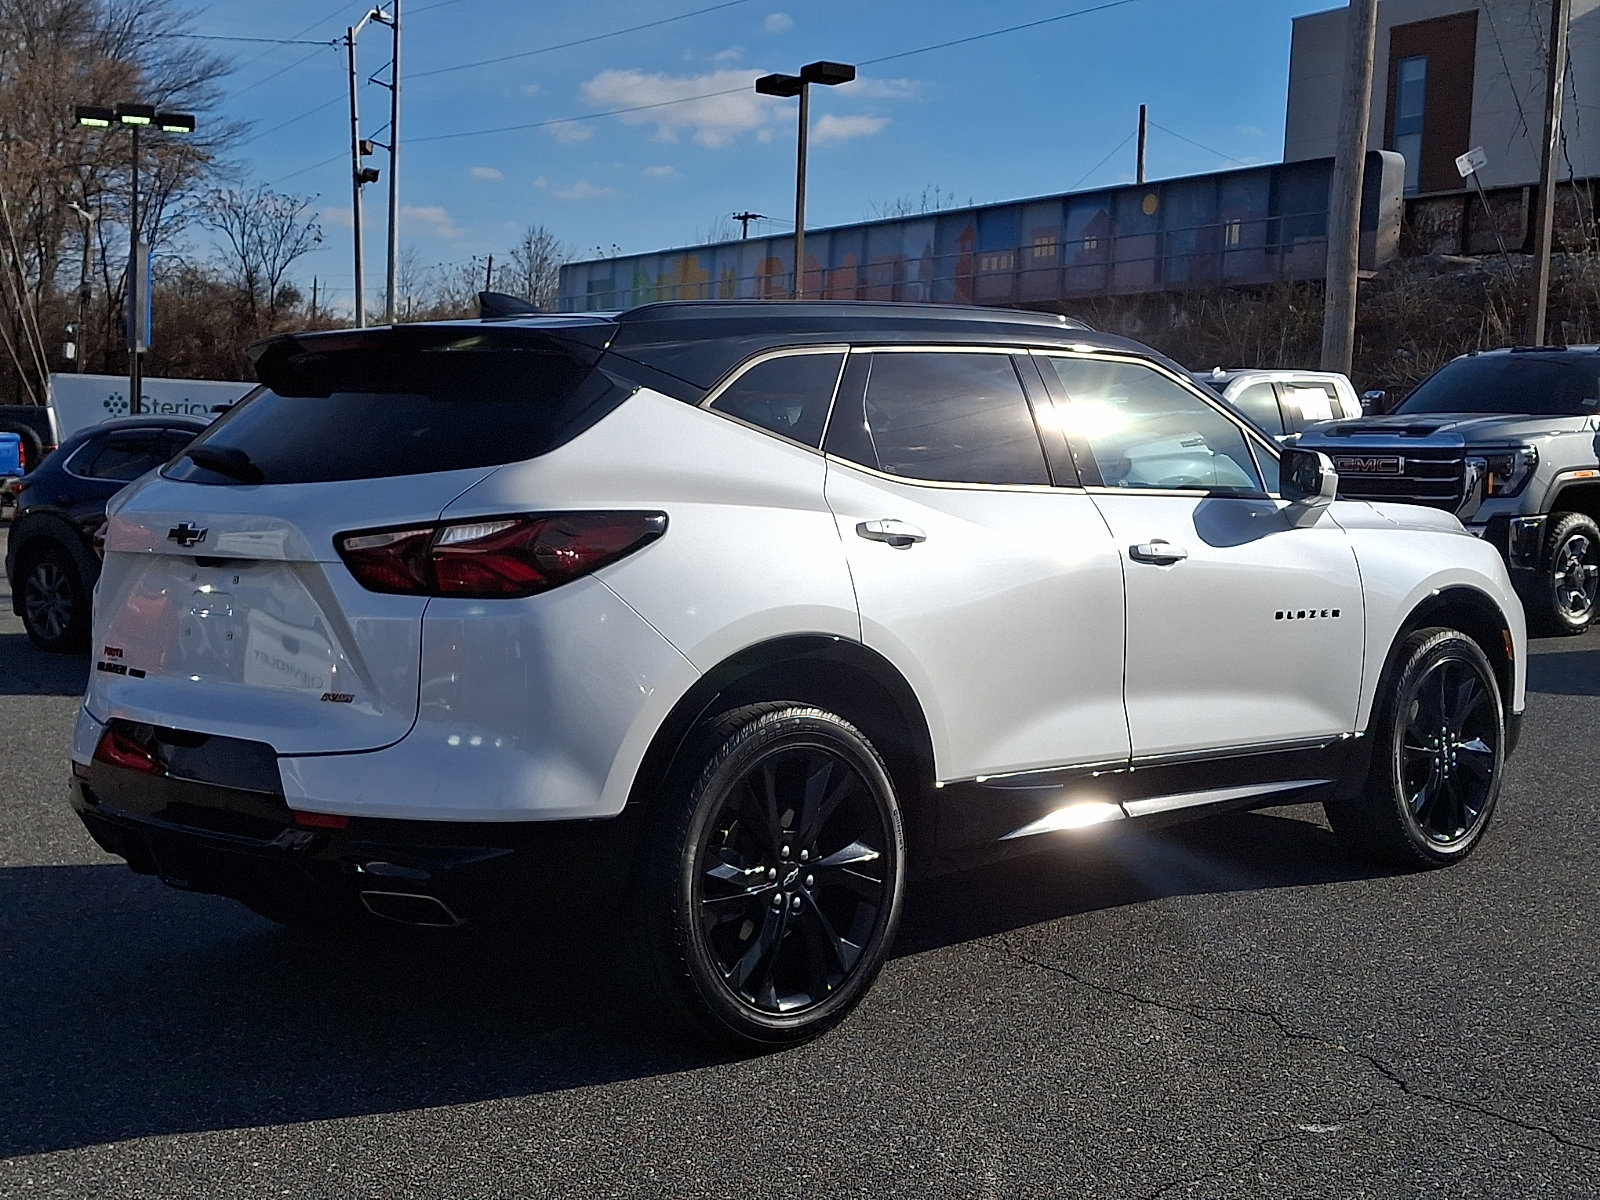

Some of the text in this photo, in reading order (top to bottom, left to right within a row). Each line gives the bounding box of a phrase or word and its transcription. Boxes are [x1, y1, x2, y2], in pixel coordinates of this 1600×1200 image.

[140, 396, 234, 414] Stericy
[1336, 457, 1398, 472] GMC
[1275, 609, 1341, 620] BLAZER
